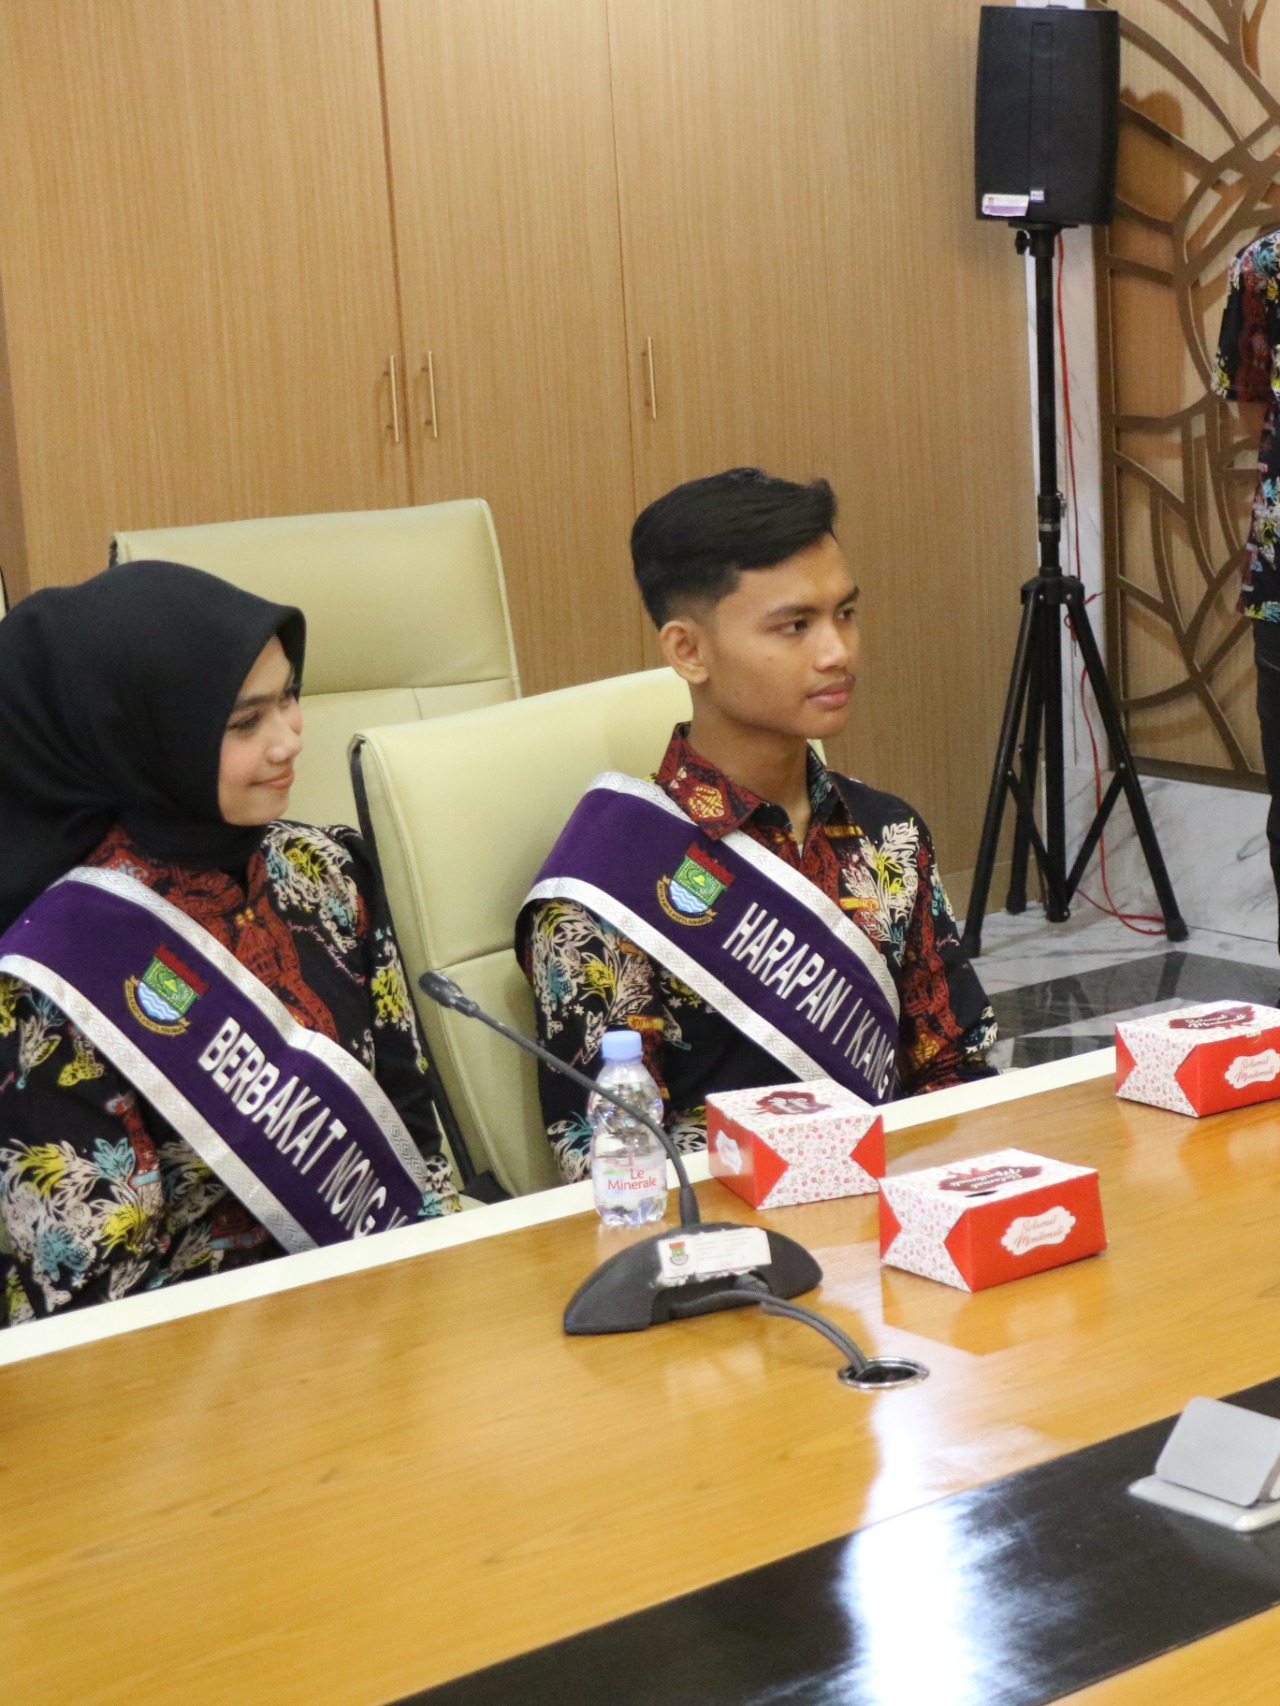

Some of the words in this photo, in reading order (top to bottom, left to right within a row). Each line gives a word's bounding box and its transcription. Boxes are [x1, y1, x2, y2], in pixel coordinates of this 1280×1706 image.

[722, 902, 853, 1032] HARAPAN
[832, 997, 863, 1045] I
[844, 1009, 895, 1099] KANG
[198, 1017, 347, 1176] BERBAKAT
[317, 1141, 387, 1239] NONG
[608, 1176, 657, 1190] Minerale
[630, 1168, 645, 1180] Le
